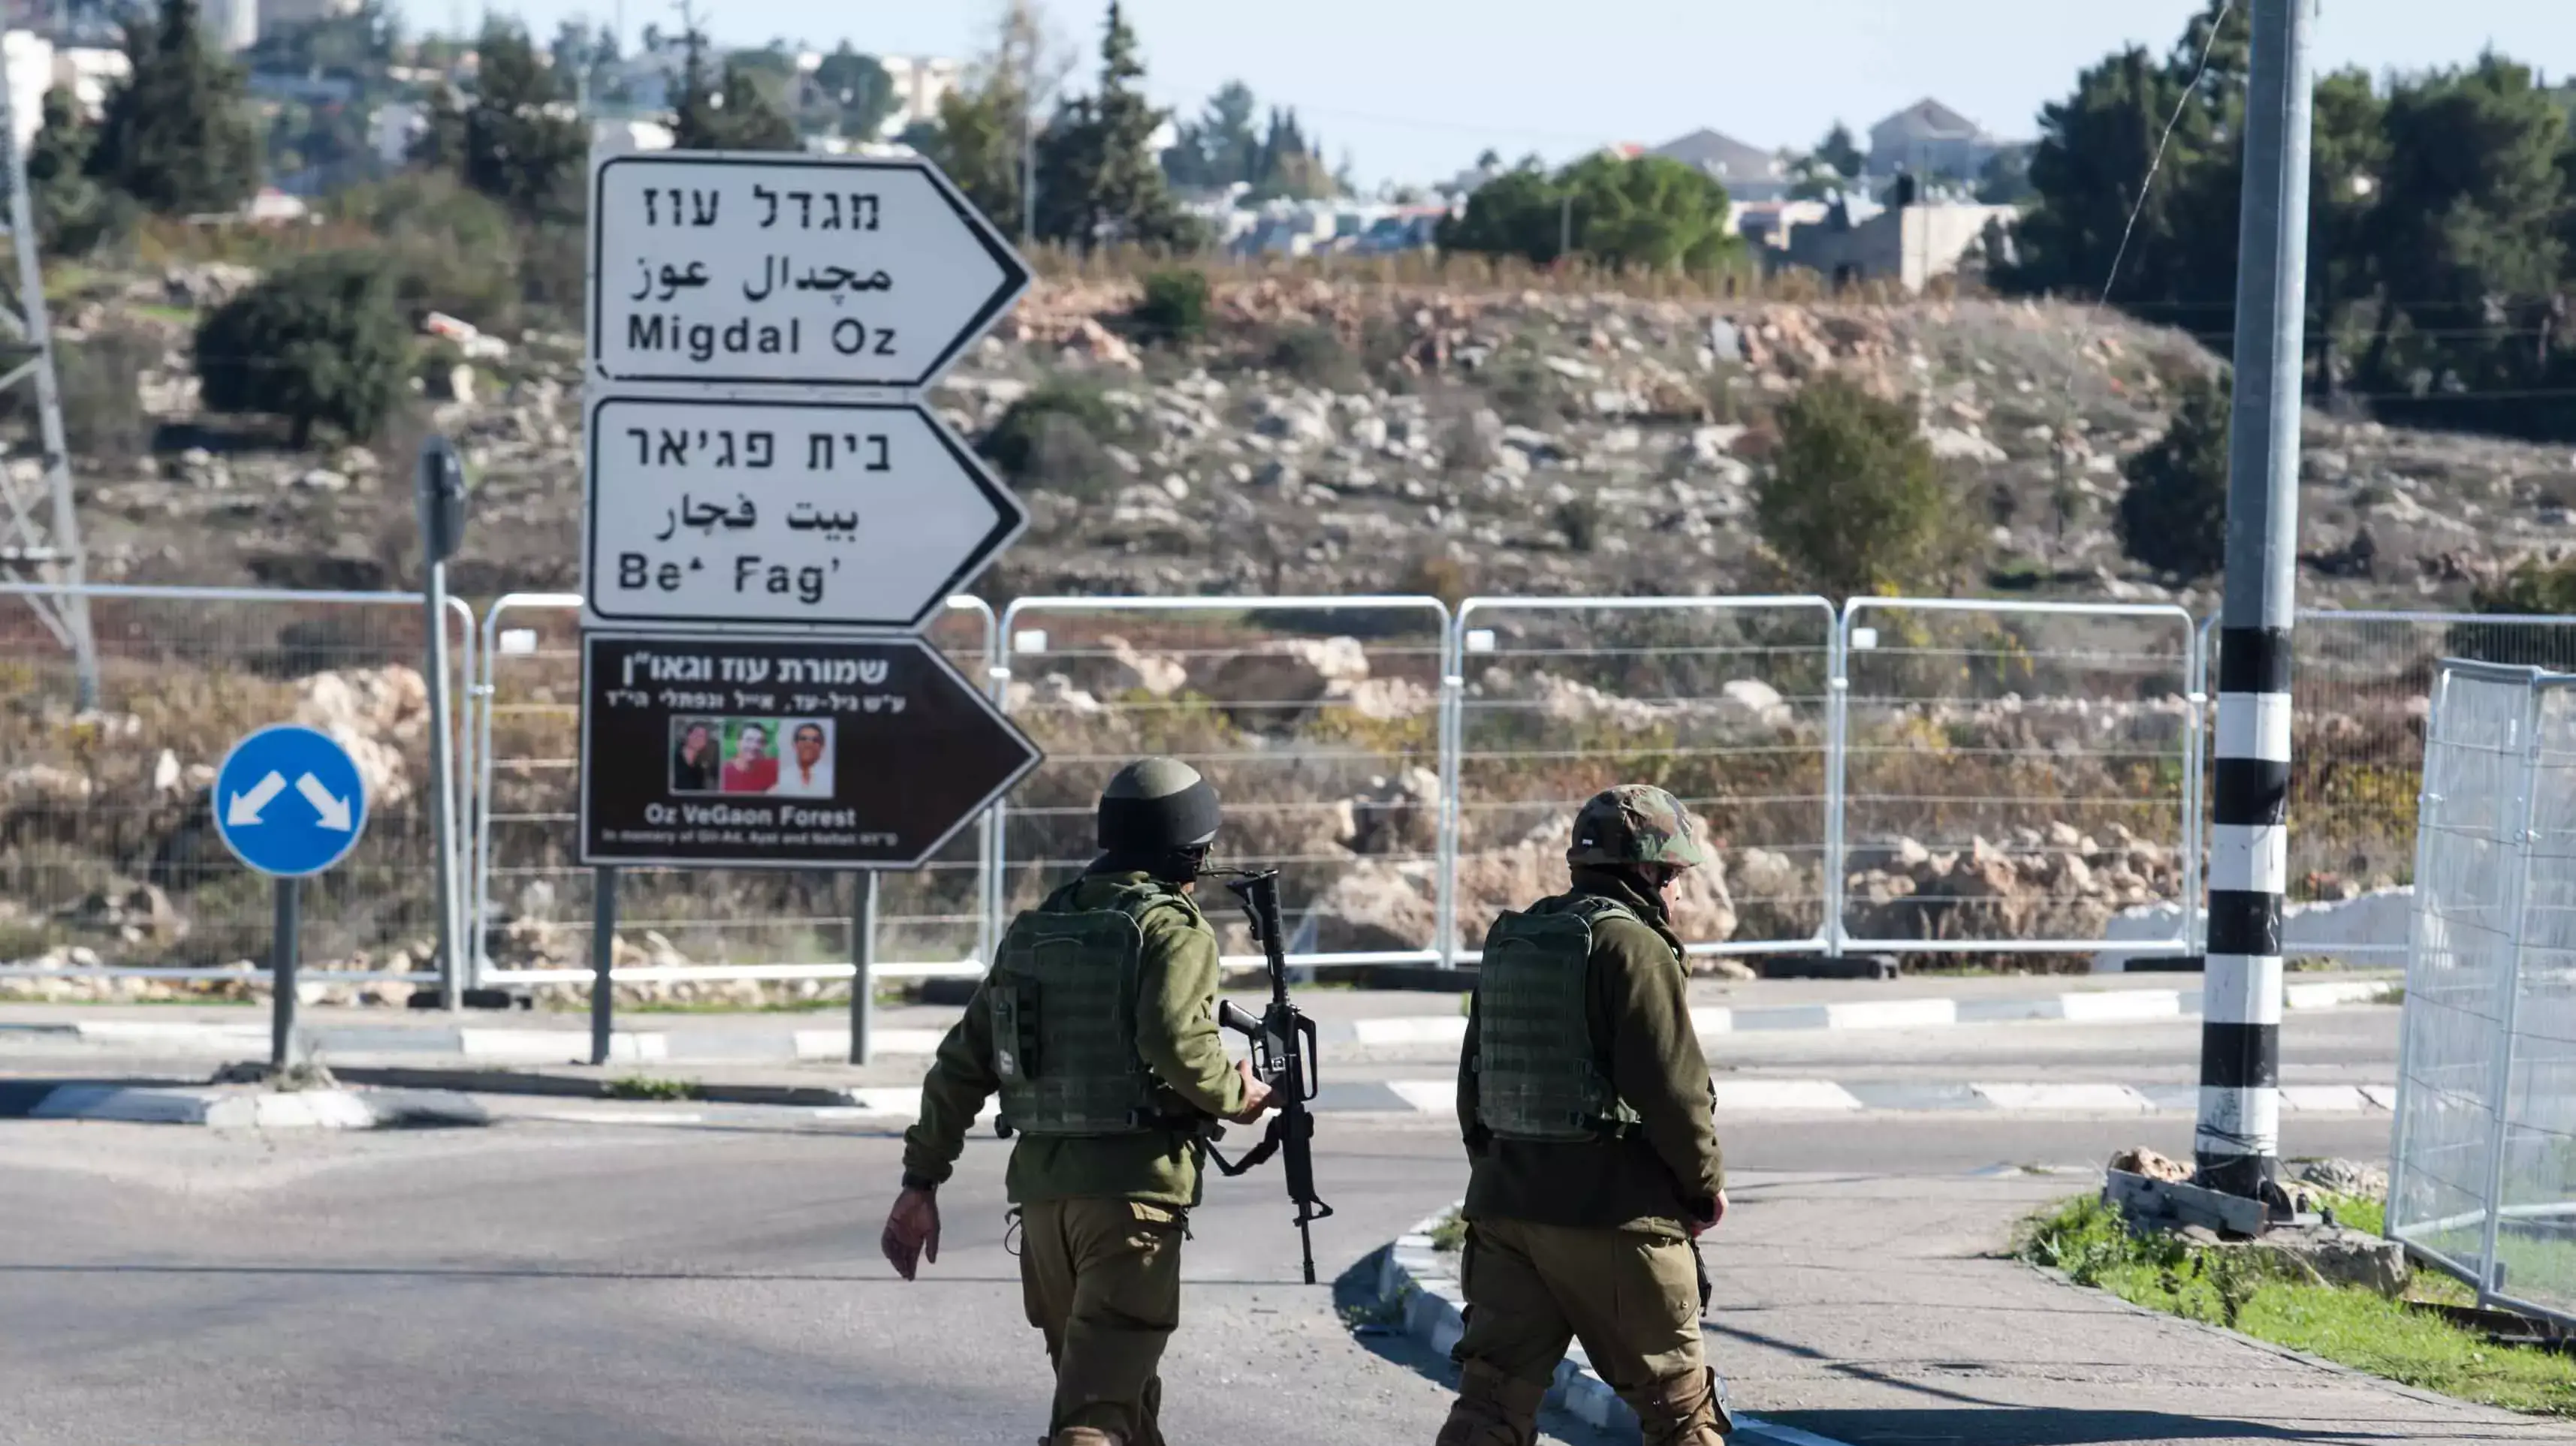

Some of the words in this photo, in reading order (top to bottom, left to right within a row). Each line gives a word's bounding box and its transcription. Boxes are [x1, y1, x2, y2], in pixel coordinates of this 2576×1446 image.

[644, 188, 719, 226] עוז
[753, 185, 879, 230] מגדל
[632, 259, 709, 301] عوز
[629, 314, 798, 362] Migdal
[832, 318, 895, 355] Oz
[807, 433, 891, 471] בית
[656, 495, 756, 541] فجار
[787, 504, 858, 541] بيت
[720, 658, 769, 683] עוז
[777, 659, 888, 684] שמורת
[645, 803, 677, 824] Oz
[683, 804, 772, 825] VeGaon
[780, 806, 855, 827] Forest
